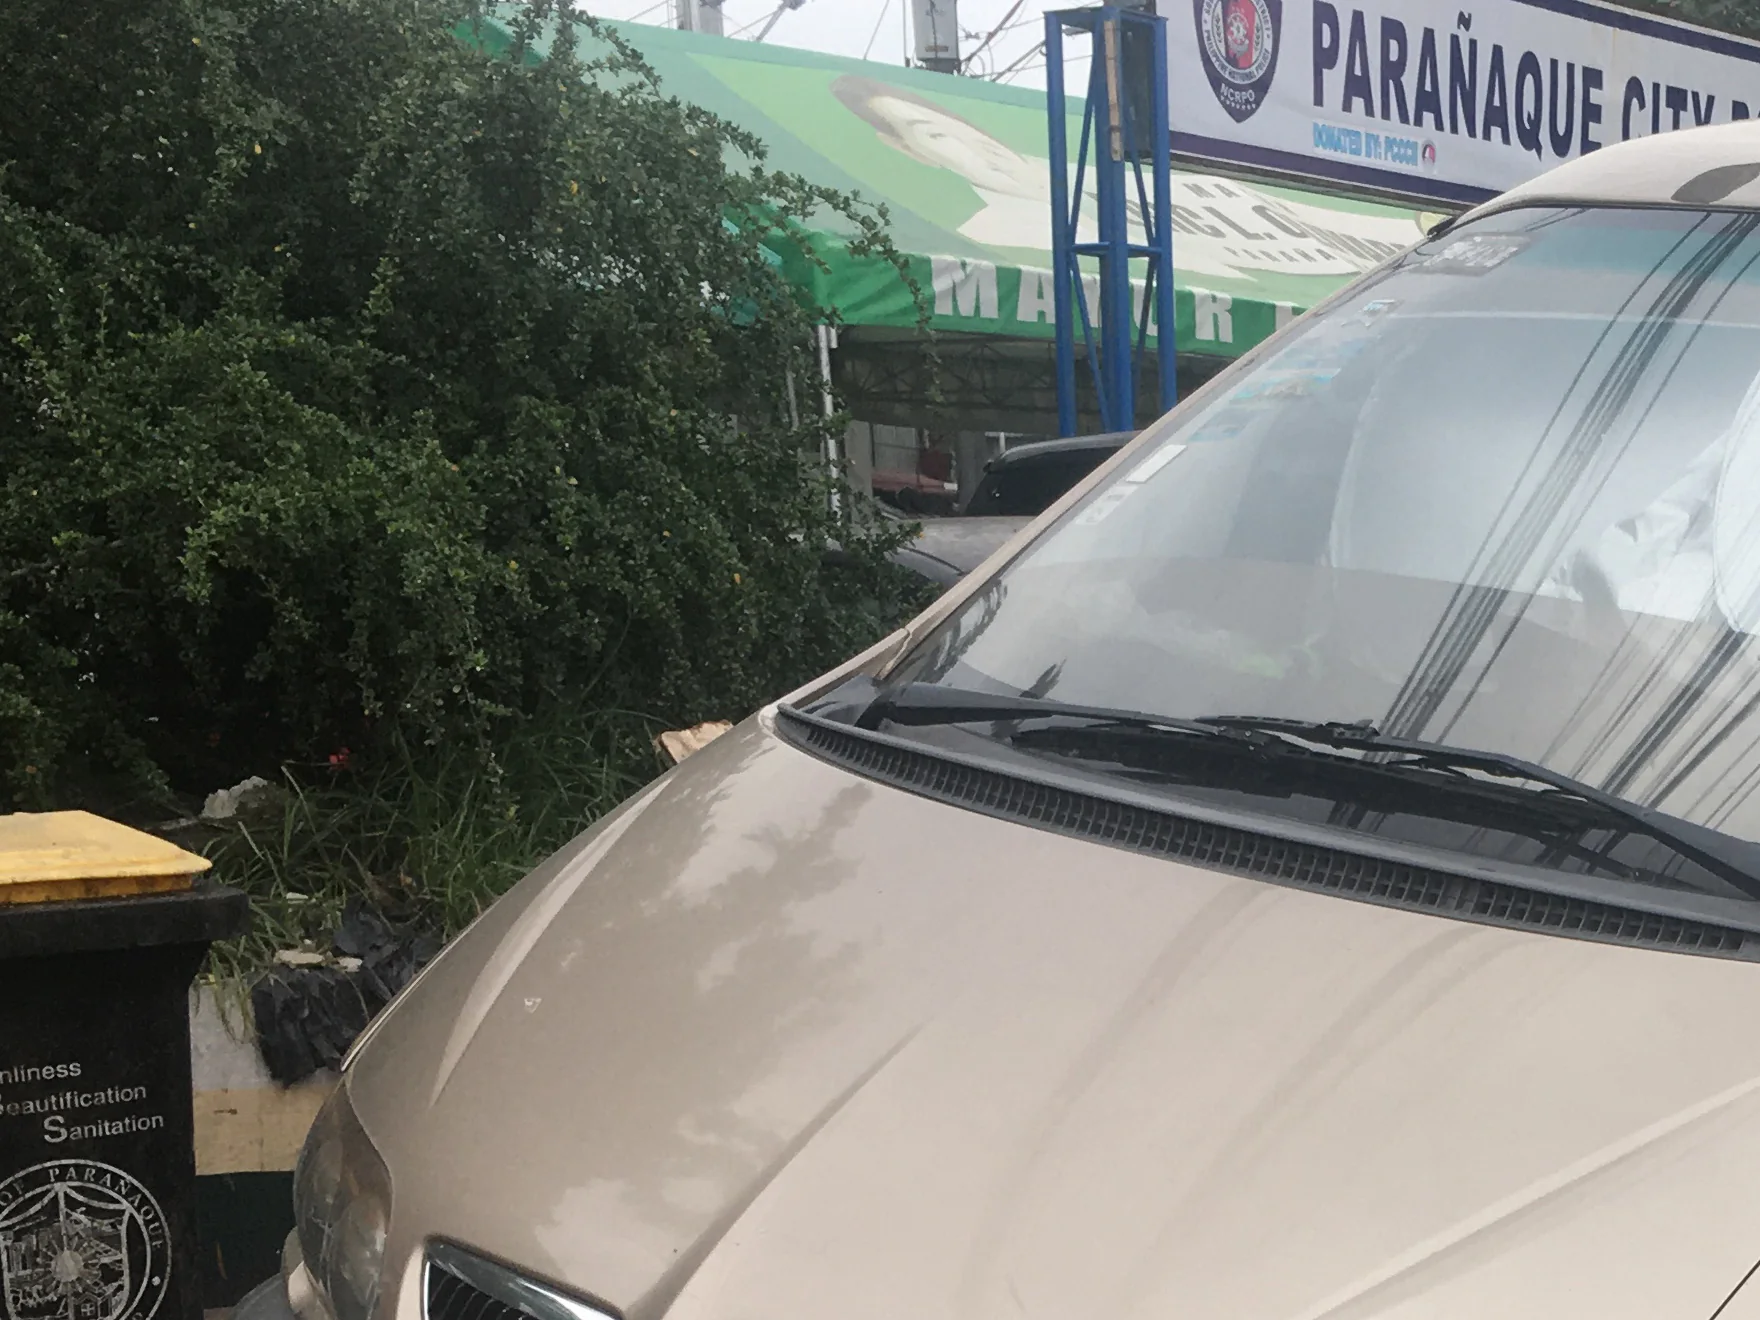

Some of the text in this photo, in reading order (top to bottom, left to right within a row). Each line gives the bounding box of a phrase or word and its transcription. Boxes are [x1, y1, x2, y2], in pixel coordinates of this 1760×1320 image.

[1220, 83, 1255, 103] NCRPO
[1312, 0, 1715, 162] PARAÑAQUE CITY
[1312, 121, 1363, 157] DONATED
[0, 1086, 147, 1116] eautification
[43, 1115, 164, 1144] Sanitation
